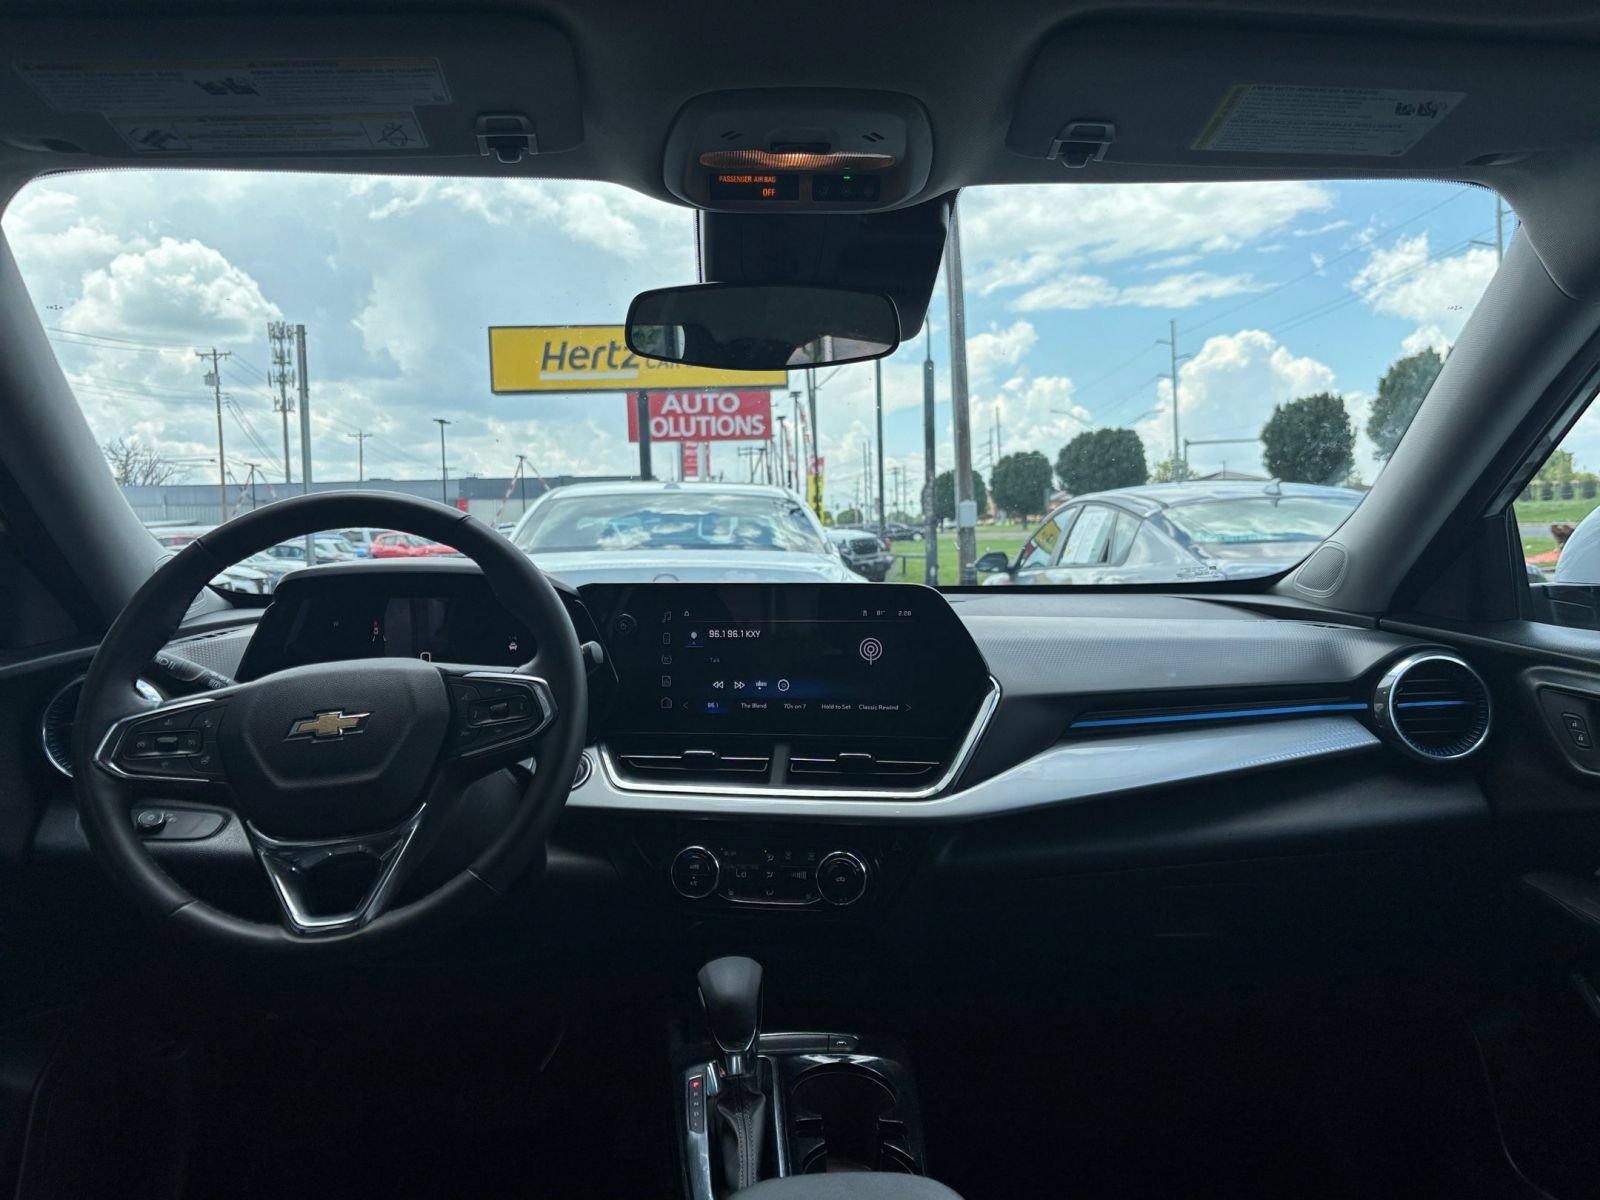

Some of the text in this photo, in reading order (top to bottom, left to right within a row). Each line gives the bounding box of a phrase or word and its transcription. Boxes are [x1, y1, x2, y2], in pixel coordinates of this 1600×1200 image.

[762, 188, 776, 196] OFF
[541, 341, 640, 370] Hertz
[661, 392, 741, 414] AUTO
[649, 415, 766, 438] OLUTIONS
[708, 629, 726, 638] 96.1
[727, 629, 744, 638] 96.1
